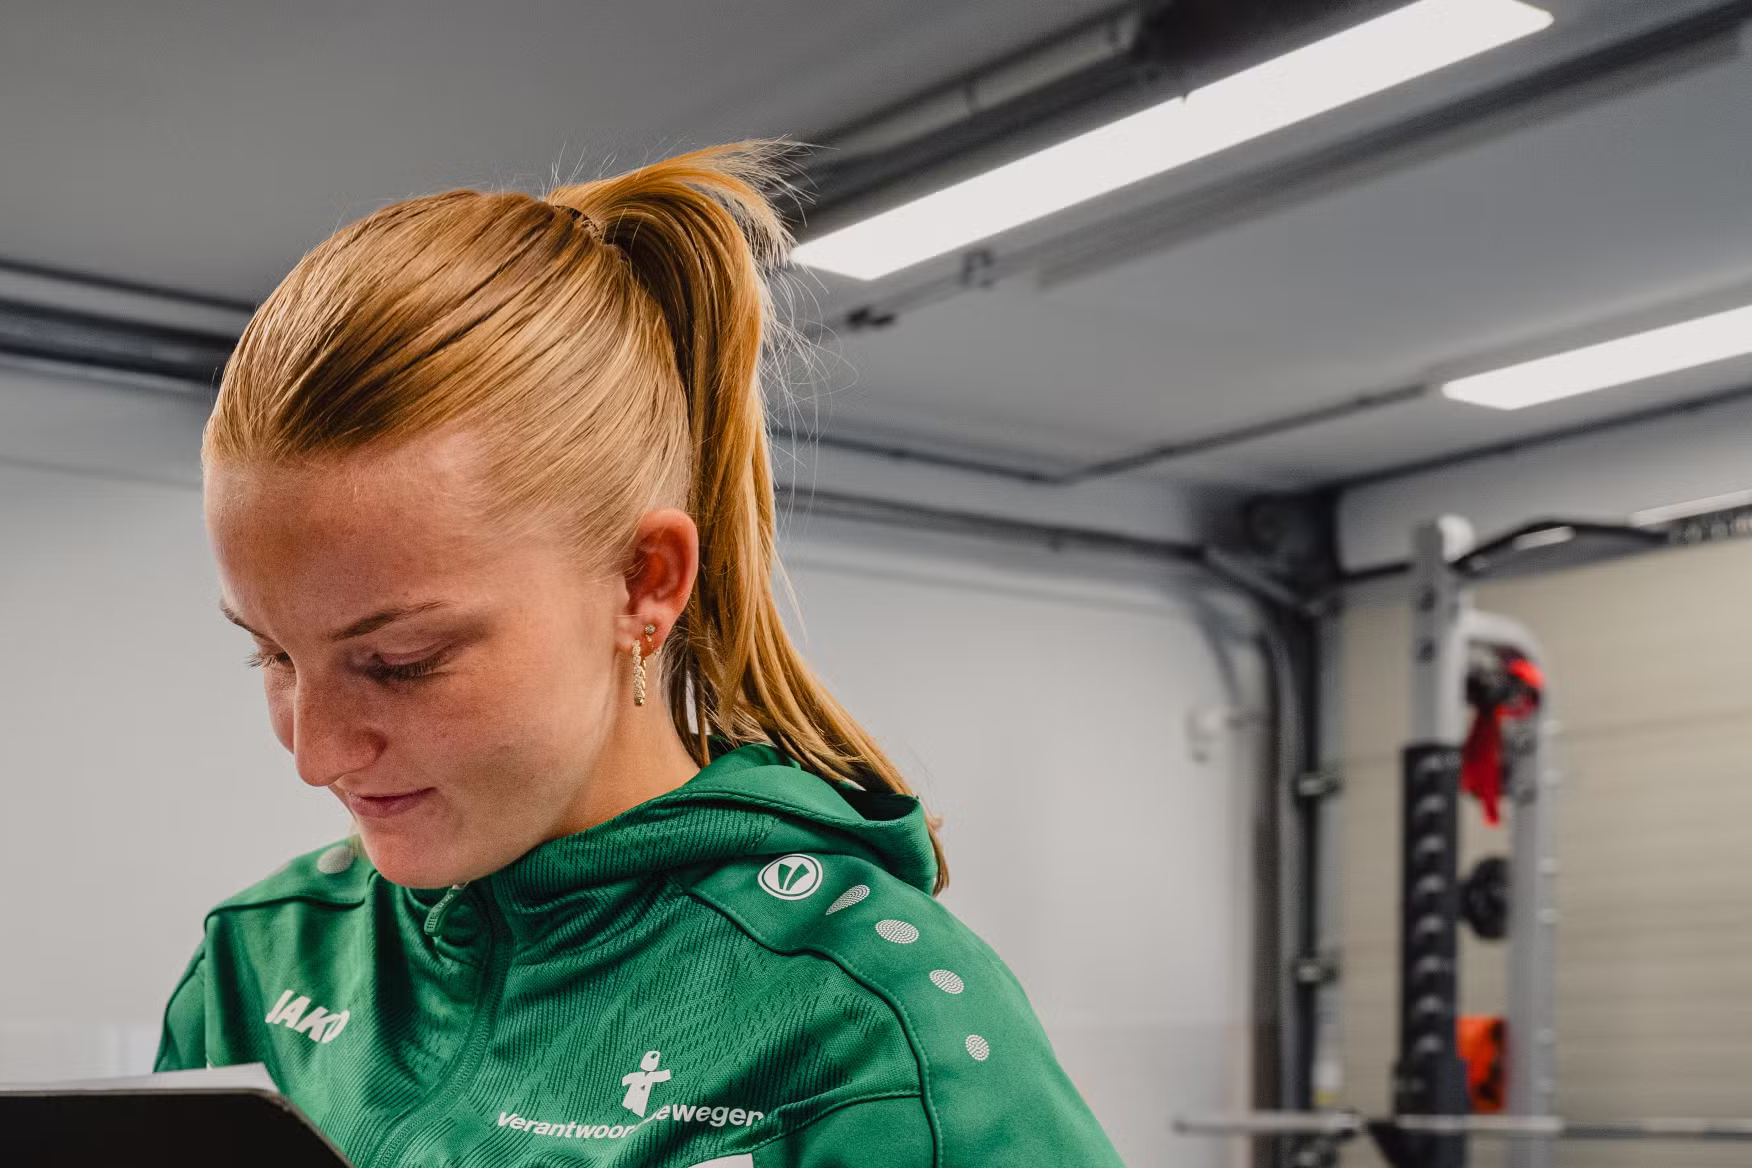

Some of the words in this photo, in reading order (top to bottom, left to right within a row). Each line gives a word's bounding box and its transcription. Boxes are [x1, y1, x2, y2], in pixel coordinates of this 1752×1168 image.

[265, 989, 350, 1044] JAKO
[498, 1111, 640, 1139] Verantwoor
[650, 1103, 764, 1128] ewegen
